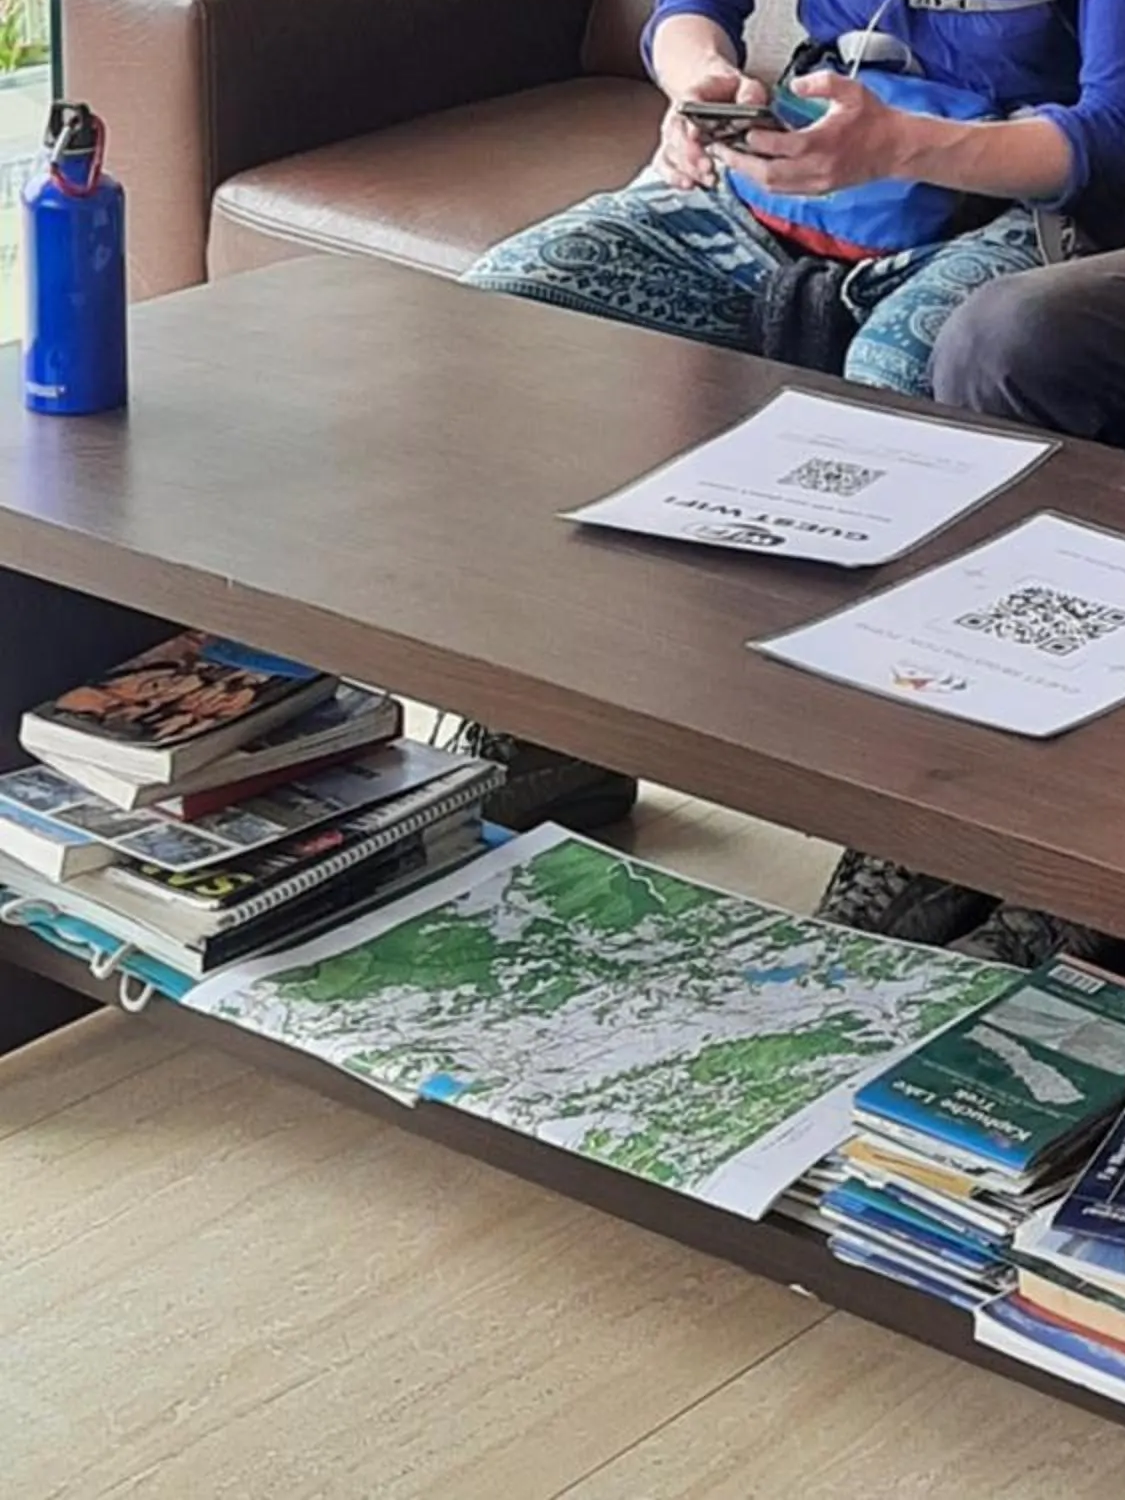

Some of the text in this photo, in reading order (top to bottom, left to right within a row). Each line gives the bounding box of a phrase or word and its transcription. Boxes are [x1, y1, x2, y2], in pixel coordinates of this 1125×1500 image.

[664, 496, 742, 518] WIFI
[749, 513, 870, 542] GUEST
[892, 1079, 938, 1105] Lake
[955, 1088, 996, 1112] Trek
[940, 1098, 1033, 1142] Kaphuche
